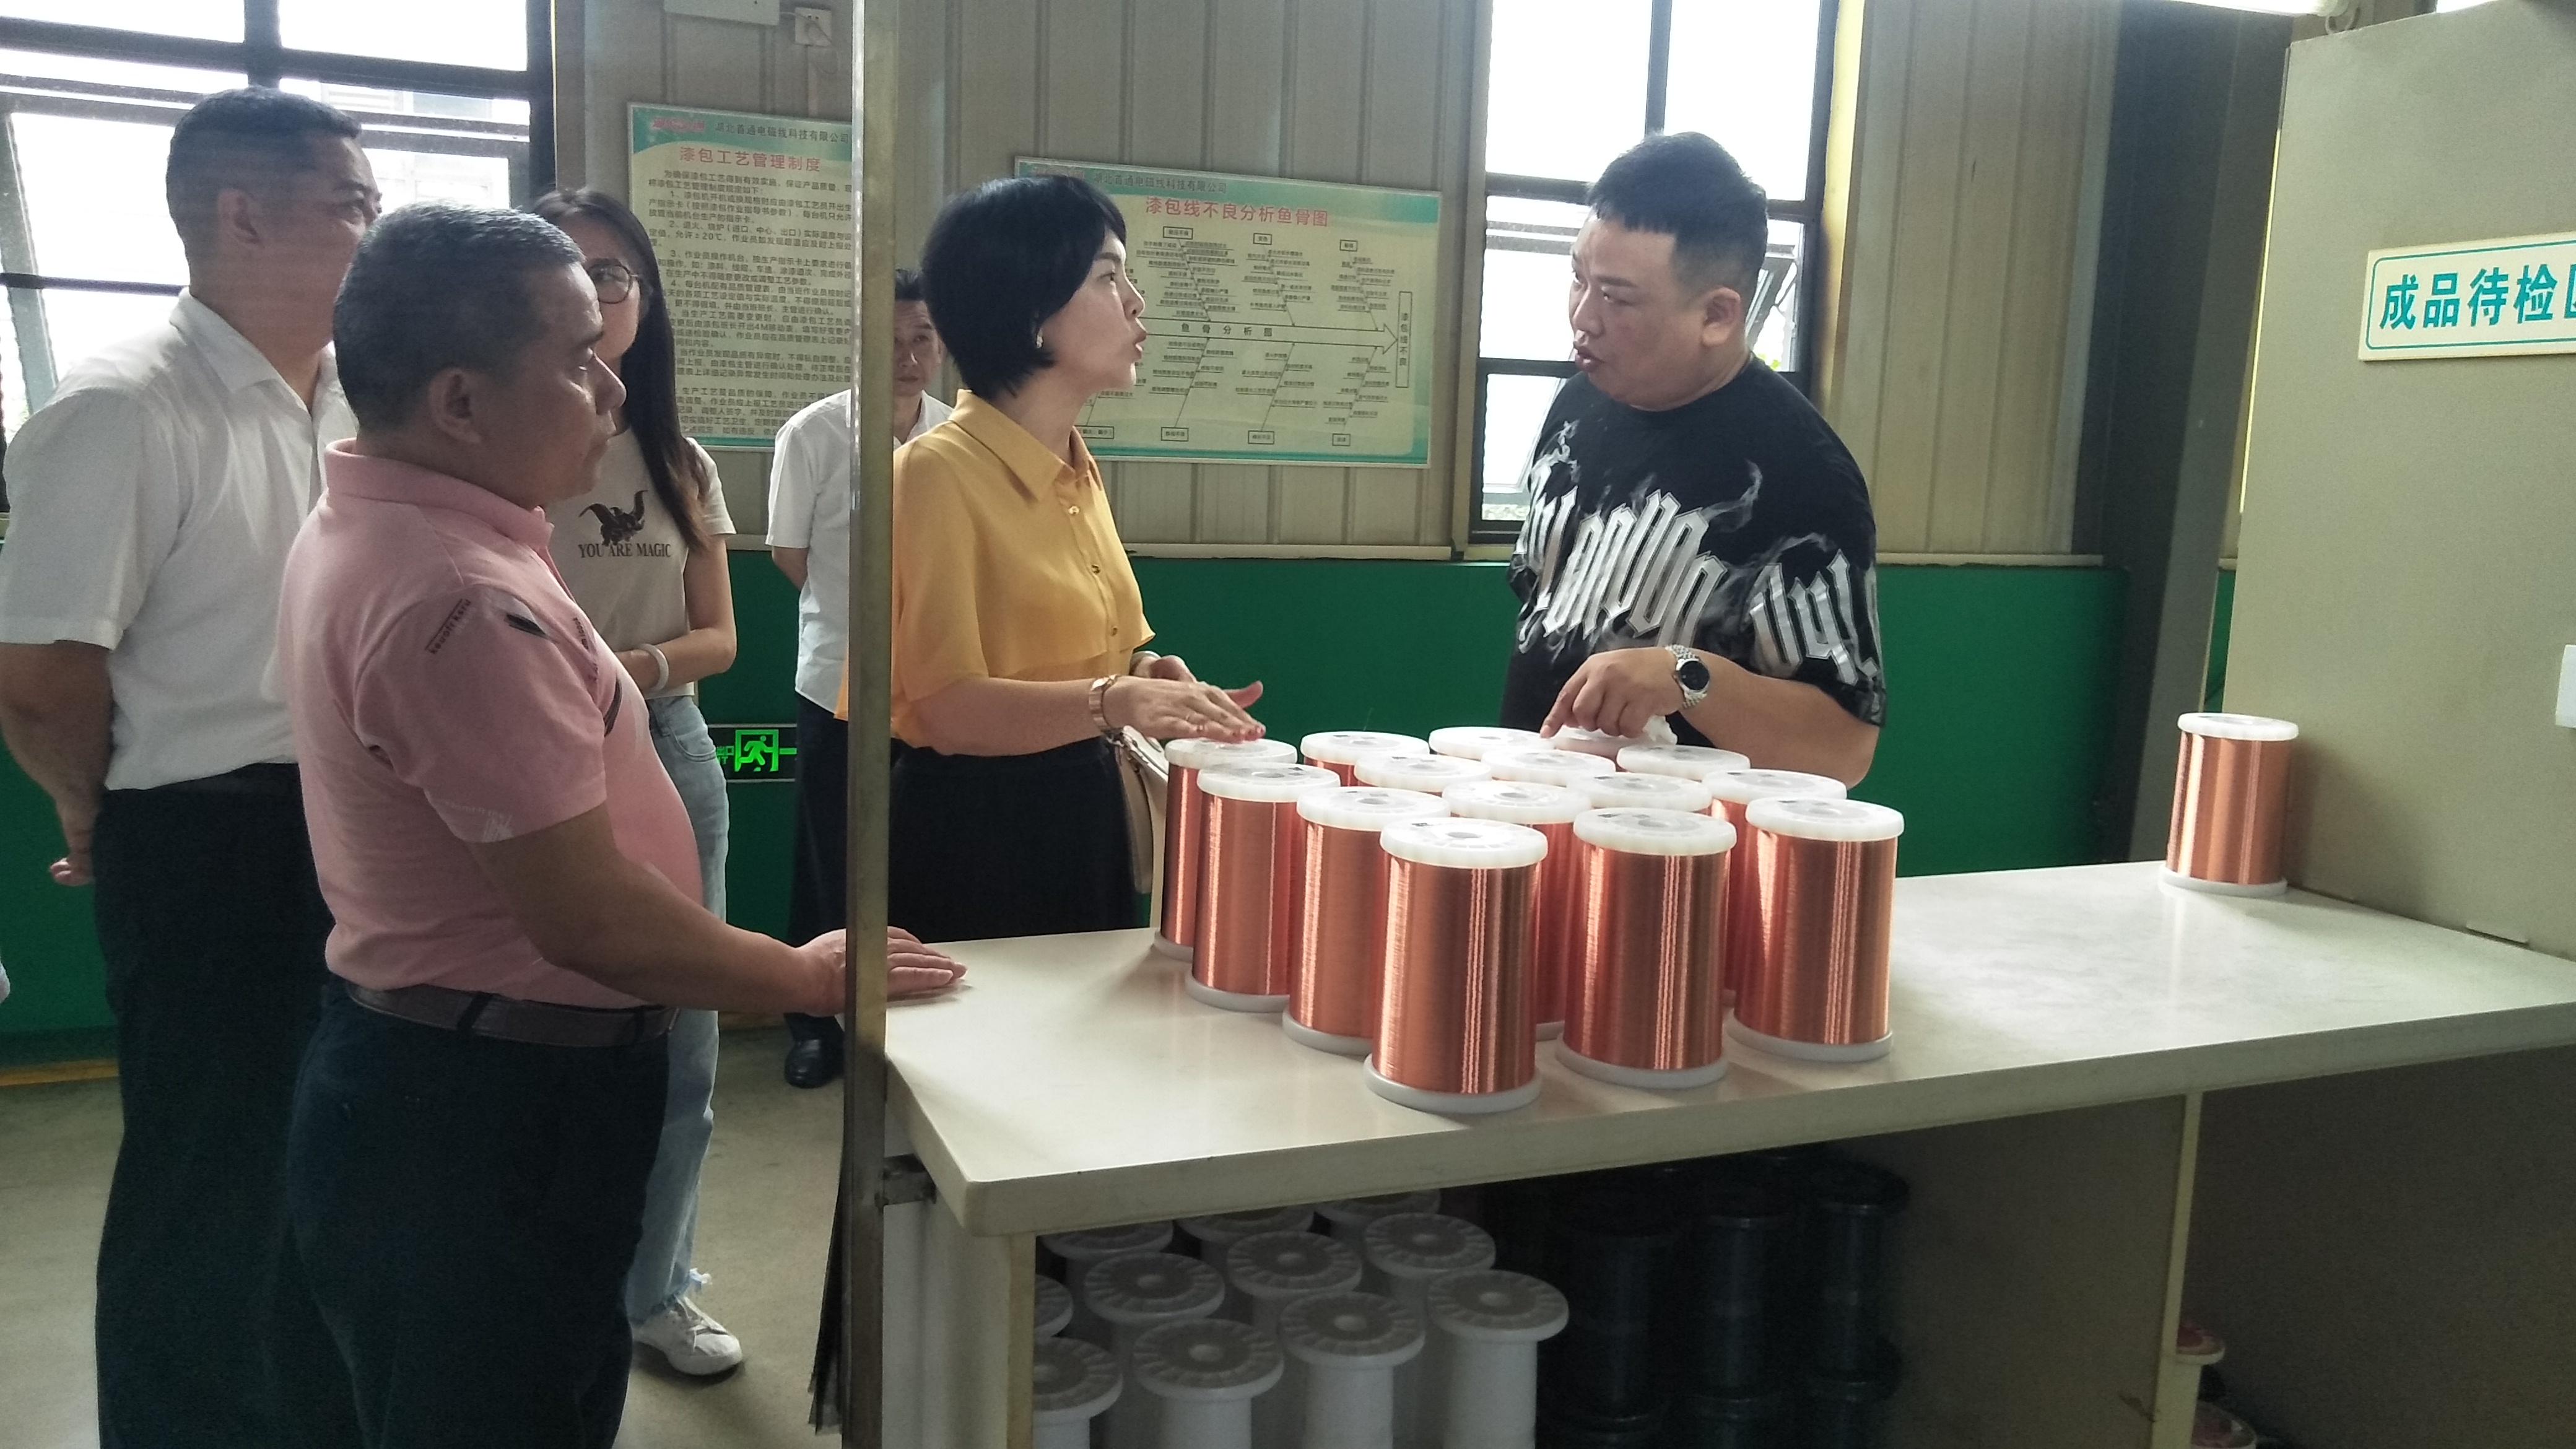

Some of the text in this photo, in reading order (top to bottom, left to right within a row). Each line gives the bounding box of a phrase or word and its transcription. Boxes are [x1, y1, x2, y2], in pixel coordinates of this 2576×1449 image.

[680, 146, 820, 172] 漆包工艺管理制度
[1146, 196, 1328, 227] 漆包线不良分析鱼骨图
[578, 542, 671, 558] YOU ARE MAGIC
